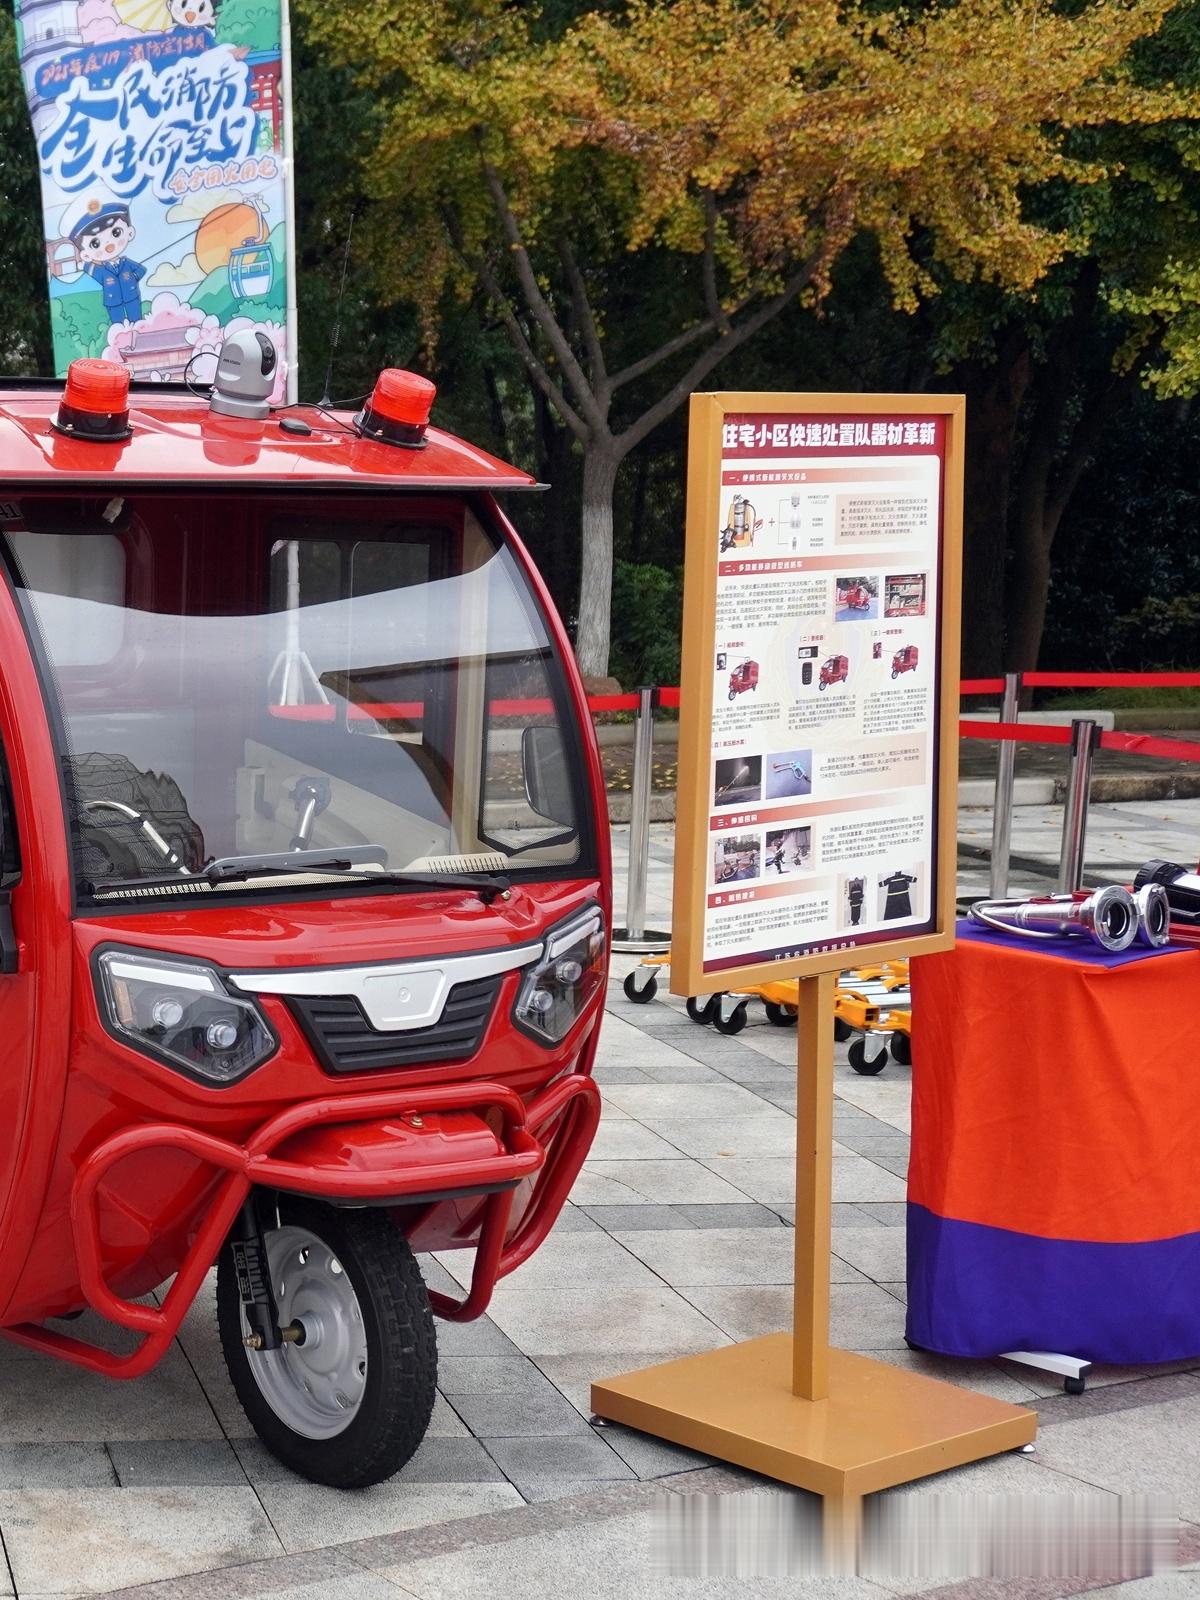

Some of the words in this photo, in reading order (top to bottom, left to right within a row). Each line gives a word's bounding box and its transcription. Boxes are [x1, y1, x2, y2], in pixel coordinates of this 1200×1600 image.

[722, 422, 936, 448] 住宅小区快速处置队器材革新
